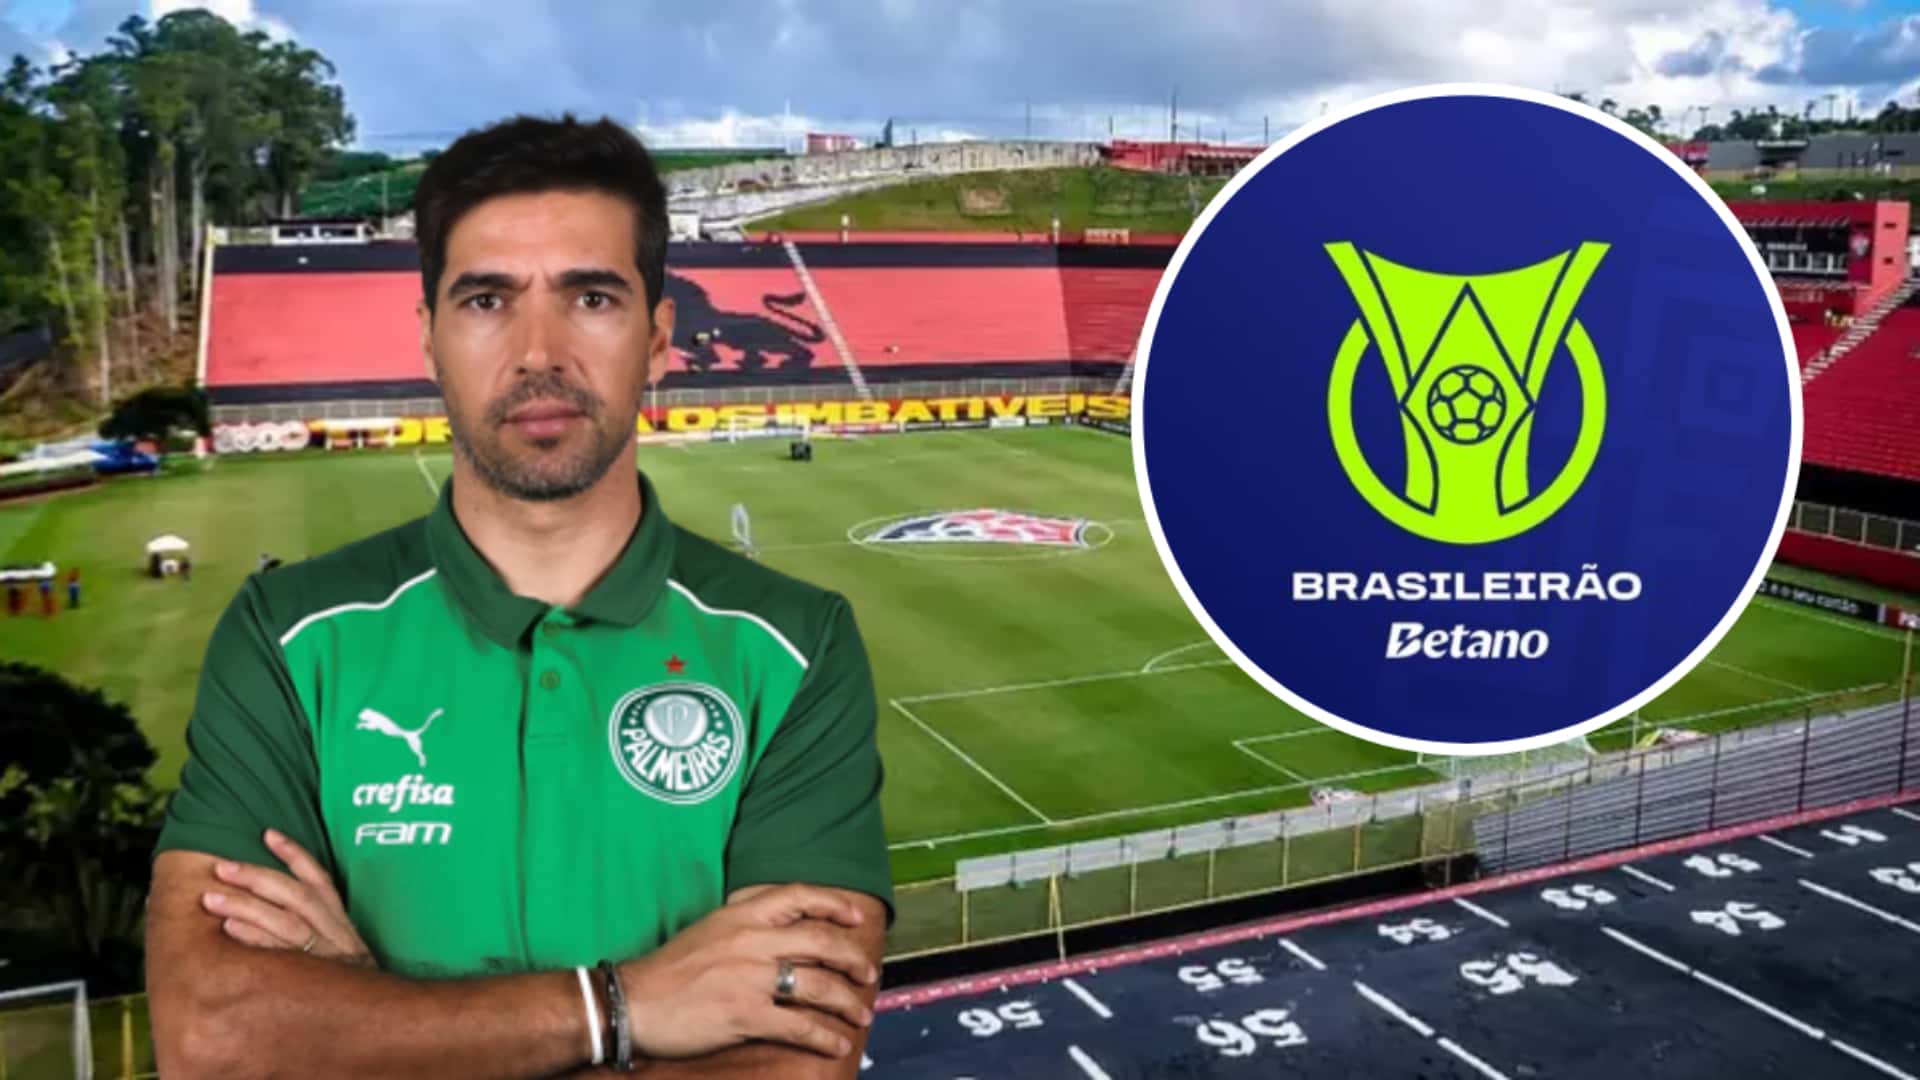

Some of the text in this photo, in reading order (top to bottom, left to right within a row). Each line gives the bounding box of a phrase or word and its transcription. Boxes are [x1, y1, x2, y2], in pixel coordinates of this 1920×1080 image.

[621, 728, 732, 790] PALMEIRAS
[352, 774, 455, 812] crefisa
[957, 1000, 1044, 1036] 56
[1197, 1007, 1309, 1057] 56
